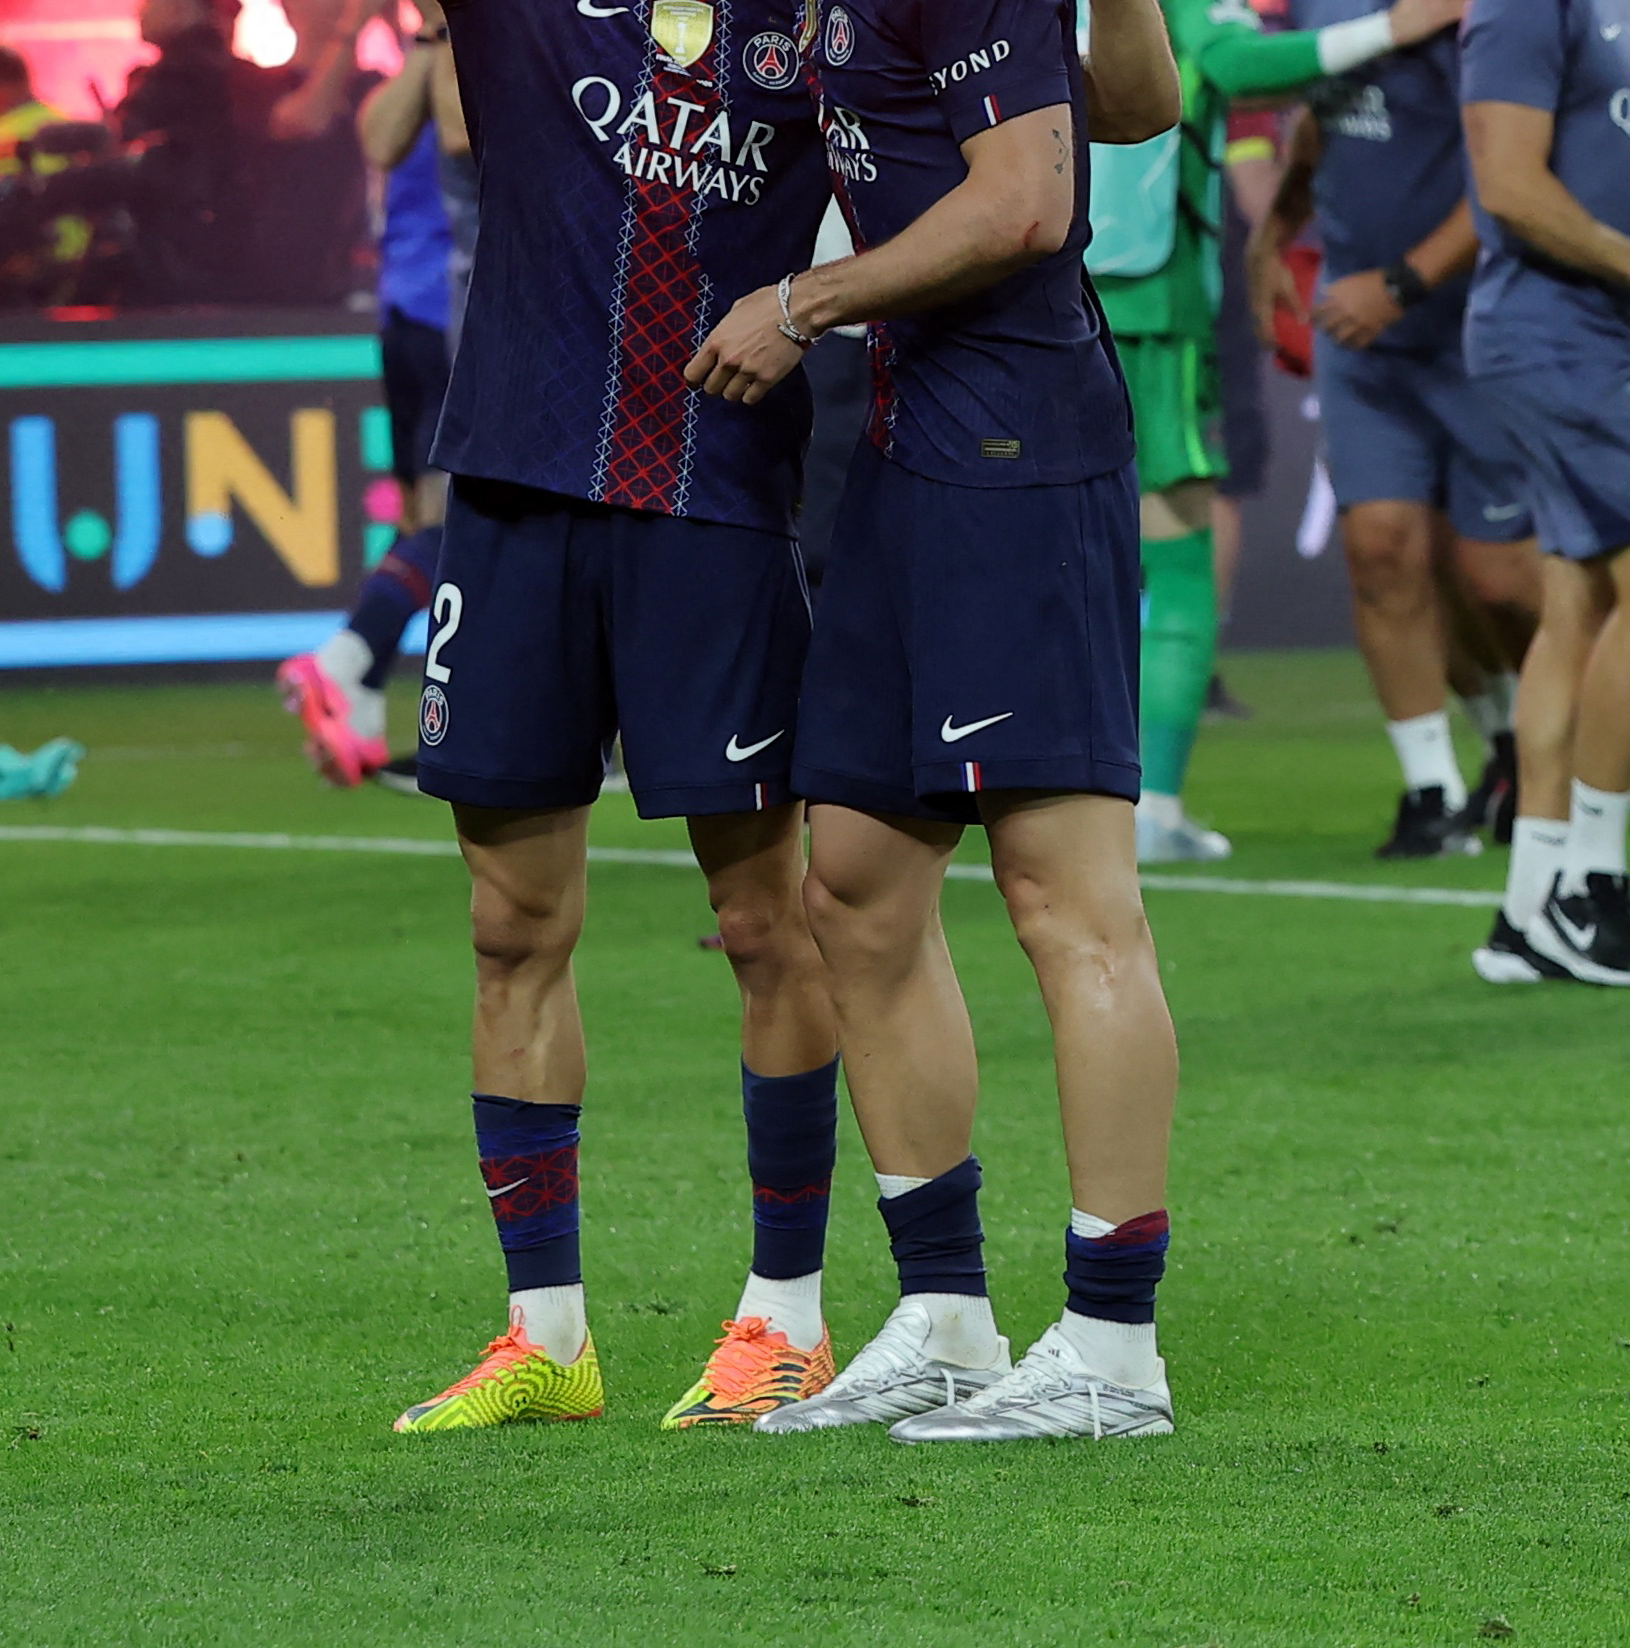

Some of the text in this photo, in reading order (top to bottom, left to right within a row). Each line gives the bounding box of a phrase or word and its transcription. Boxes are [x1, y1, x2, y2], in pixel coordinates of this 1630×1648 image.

[753, 35, 792, 52] PARIS
[571, 76, 776, 173] QATAR
[613, 142, 765, 206] AIRWAYS
[426, 582, 463, 684] 2
